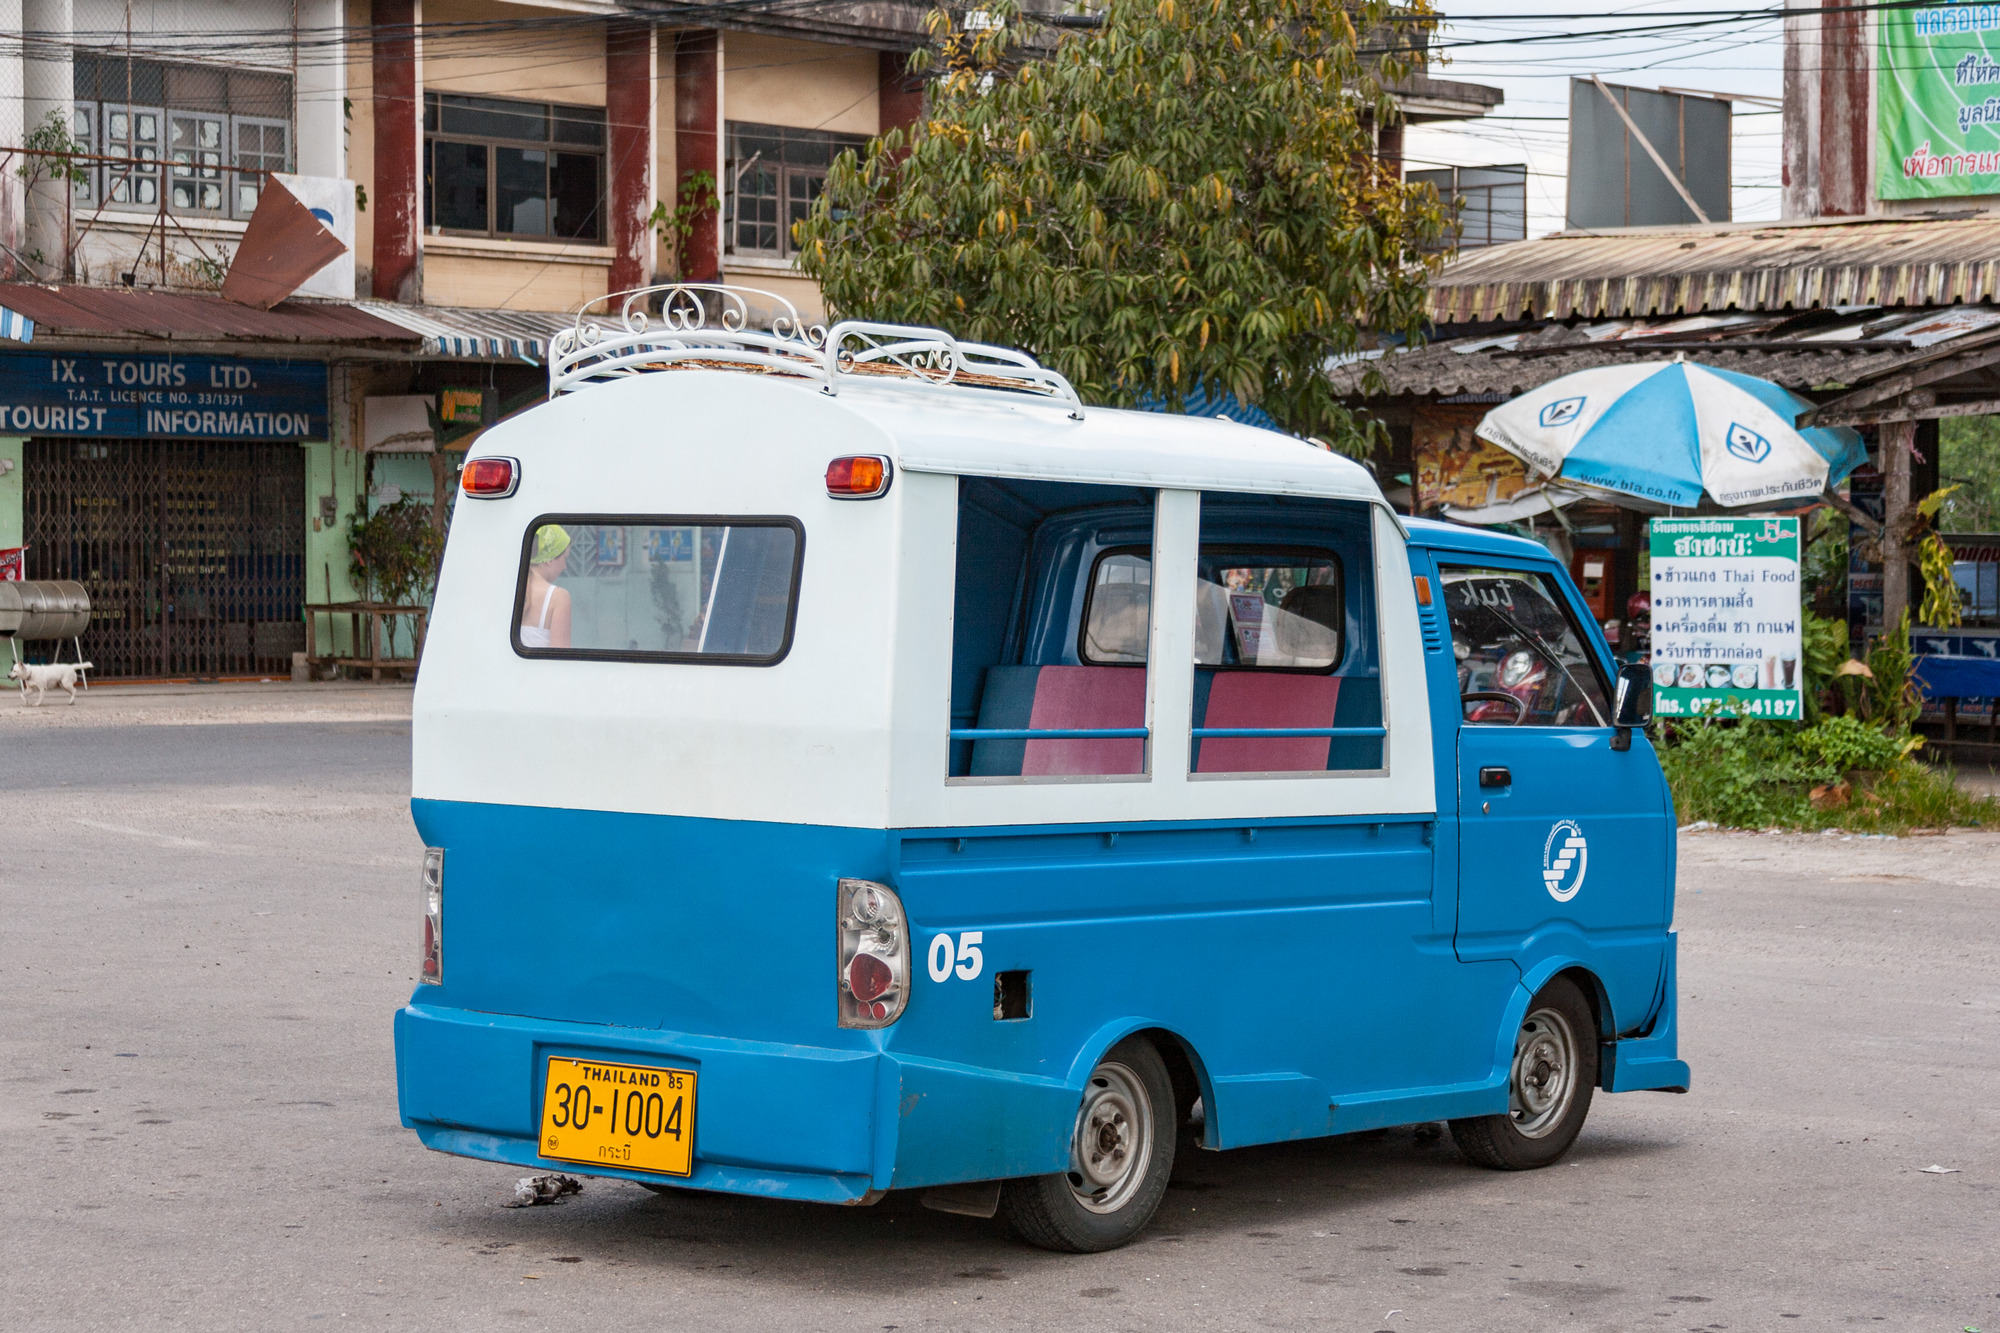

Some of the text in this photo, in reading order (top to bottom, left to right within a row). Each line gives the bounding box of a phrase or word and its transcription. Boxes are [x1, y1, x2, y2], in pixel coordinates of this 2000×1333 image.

[52, 359, 258, 389] IX. TOURS LTD.
[67, 388, 244, 406] T.A.T. LICENCE NO. 33/1371
[0, 405, 310, 436] TOURIST INFORMATION
[1580, 473, 1682, 501] www.bla.co.th
[1719, 478, 1823, 503] กรุงเทพประกันชีวิต
[1664, 566, 1796, 583] ข้าวแกง Thai Food
[1664, 588, 1754, 608] อาหารตามสั่ง
[1665, 613, 1796, 634] เครื่องดื่ม ชา กาแฟ
[1665, 641, 1763, 659] รับทำข้าวกล่อง
[927, 931, 984, 983] 05
[583, 1066, 684, 1090] THAILAND 85
[552, 1082, 684, 1142] 30-1004
